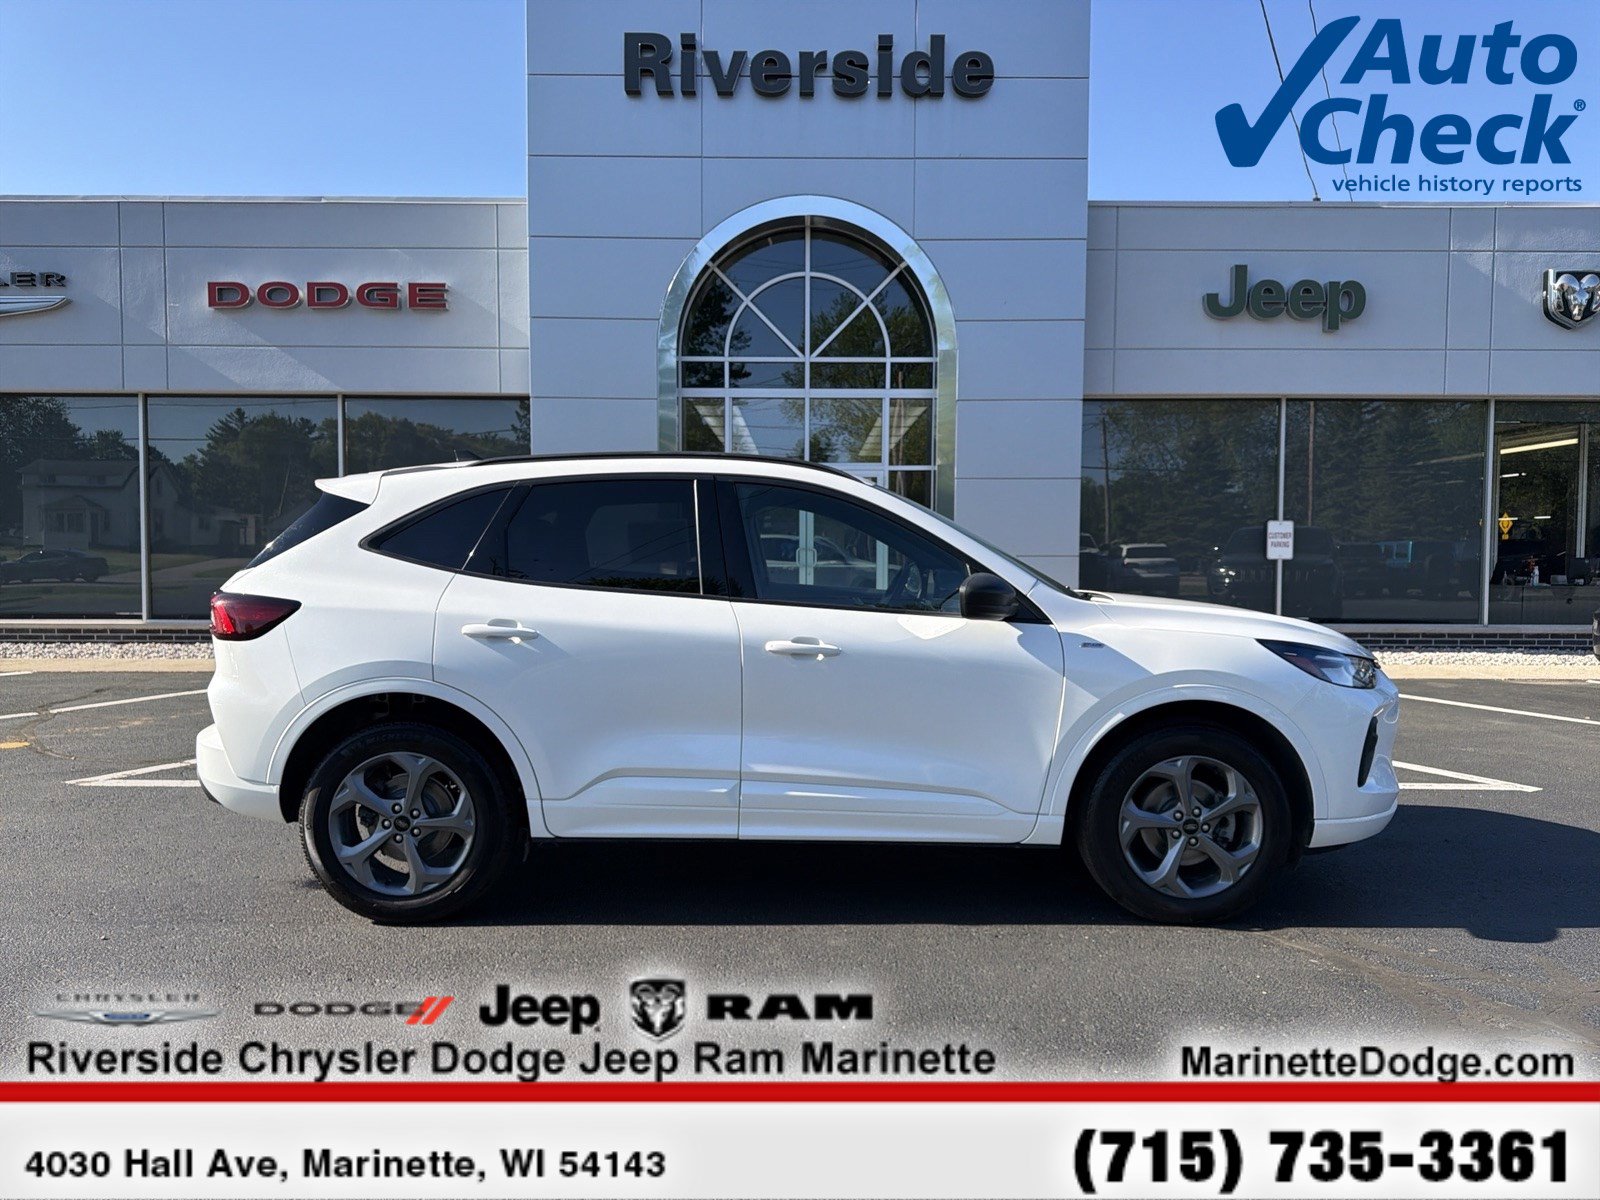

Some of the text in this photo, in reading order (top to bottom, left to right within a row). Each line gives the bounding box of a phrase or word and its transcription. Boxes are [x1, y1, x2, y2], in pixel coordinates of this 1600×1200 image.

[624, 32, 995, 98] Riverside
[207, 281, 448, 310] DODGE
[1202, 264, 1367, 333] Jeep
[1270, 540, 1290, 548] PARKING
